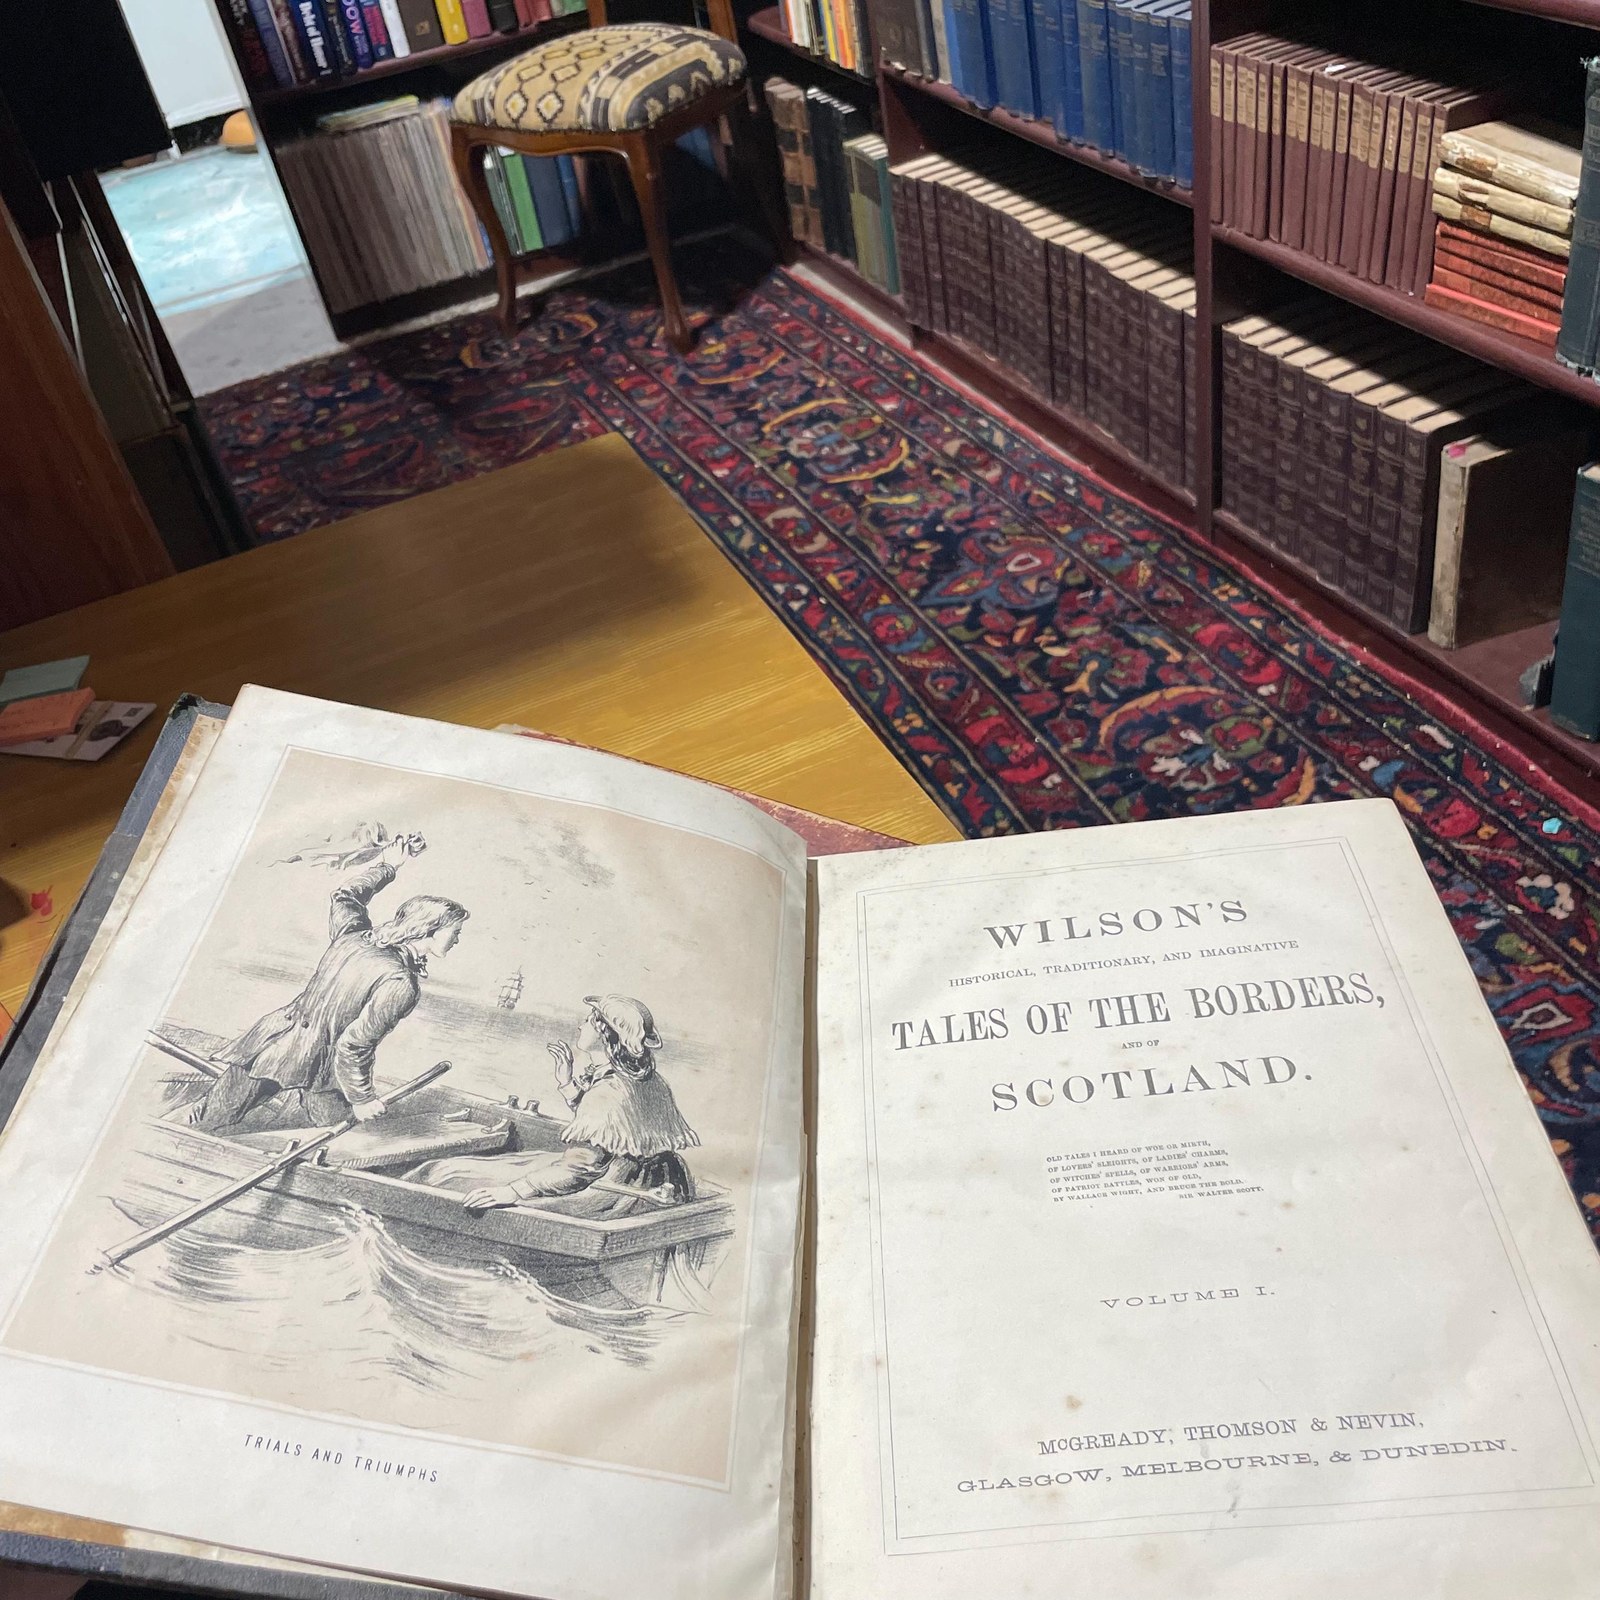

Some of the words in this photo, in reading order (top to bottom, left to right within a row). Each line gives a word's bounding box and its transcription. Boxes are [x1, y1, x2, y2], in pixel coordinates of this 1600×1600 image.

[982, 900, 1248, 950] WILSON'S
[948, 967, 1037, 988] HISTORICAL,
[1042, 955, 1156, 975] TRADITIONARY,
[1162, 951, 1192, 962] AND
[1198, 939, 1300, 958] IMAGINATIVE
[891, 1007, 1009, 1051] TALES
[1025, 1001, 1073, 1036] OF
[1087, 991, 1172, 1029] THE
[1184, 972, 1385, 1019] BORDERS,
[1120, 1041, 1143, 1050] AND
[1146, 1039, 1160, 1047] OF
[991, 1055, 1313, 1113] SCOTLAND.
[1046, 1155, 1063, 1164] OLD
[1063, 1152, 1091, 1161] TALES
[1099, 1148, 1129, 1157] HEARD
[1130, 1146, 1143, 1154] OF
[1144, 1144, 1165, 1152] WOE
[1047, 1166, 1059, 1174] OF
[1141, 1156, 1154, 1164] OF
[1190, 1149, 1229, 1158] CHARMS,
[1049, 1177, 1061, 1185] OF
[1104, 1169, 1138, 1178] SPELLS,
[1139, 1167, 1151, 1175] OF
[1202, 1160, 1229, 1168] ARMS,
[1064, 1183, 1101, 1193] PATRIOT
[1144, 1176, 1166, 1184] WON
[1181, 1173, 1202, 1181] OLD,
[1067, 1191, 1108, 1201] WALLACE
[1146, 1186, 1166, 1194] AND
[1167, 1183, 1197, 1192] BRUCE
[1198, 1181, 1218, 1189] THE
[1196, 1188, 1235, 1198] WALTER
[1235, 1185, 1265, 1194] SCOTT.
[1099, 1288, 1240, 1309] VOLUME
[1254, 1285, 1276, 1296] I.
[1183, 1418, 1297, 1442] THOMSON
[1310, 1417, 1328, 1432] &
[1335, 1412, 1424, 1431] NEVIN,
[244, 1433, 302, 1457] TRIALS
[311, 1447, 343, 1465] AND
[354, 1455, 438, 1483] TRIUMPHS
[957, 1467, 1112, 1493] GLASGOW,
[1120, 1452, 1320, 1478] MELBOURNE,
[1328, 1450, 1352, 1464] &
[1359, 1438, 1518, 1462] DUNEDIN.
